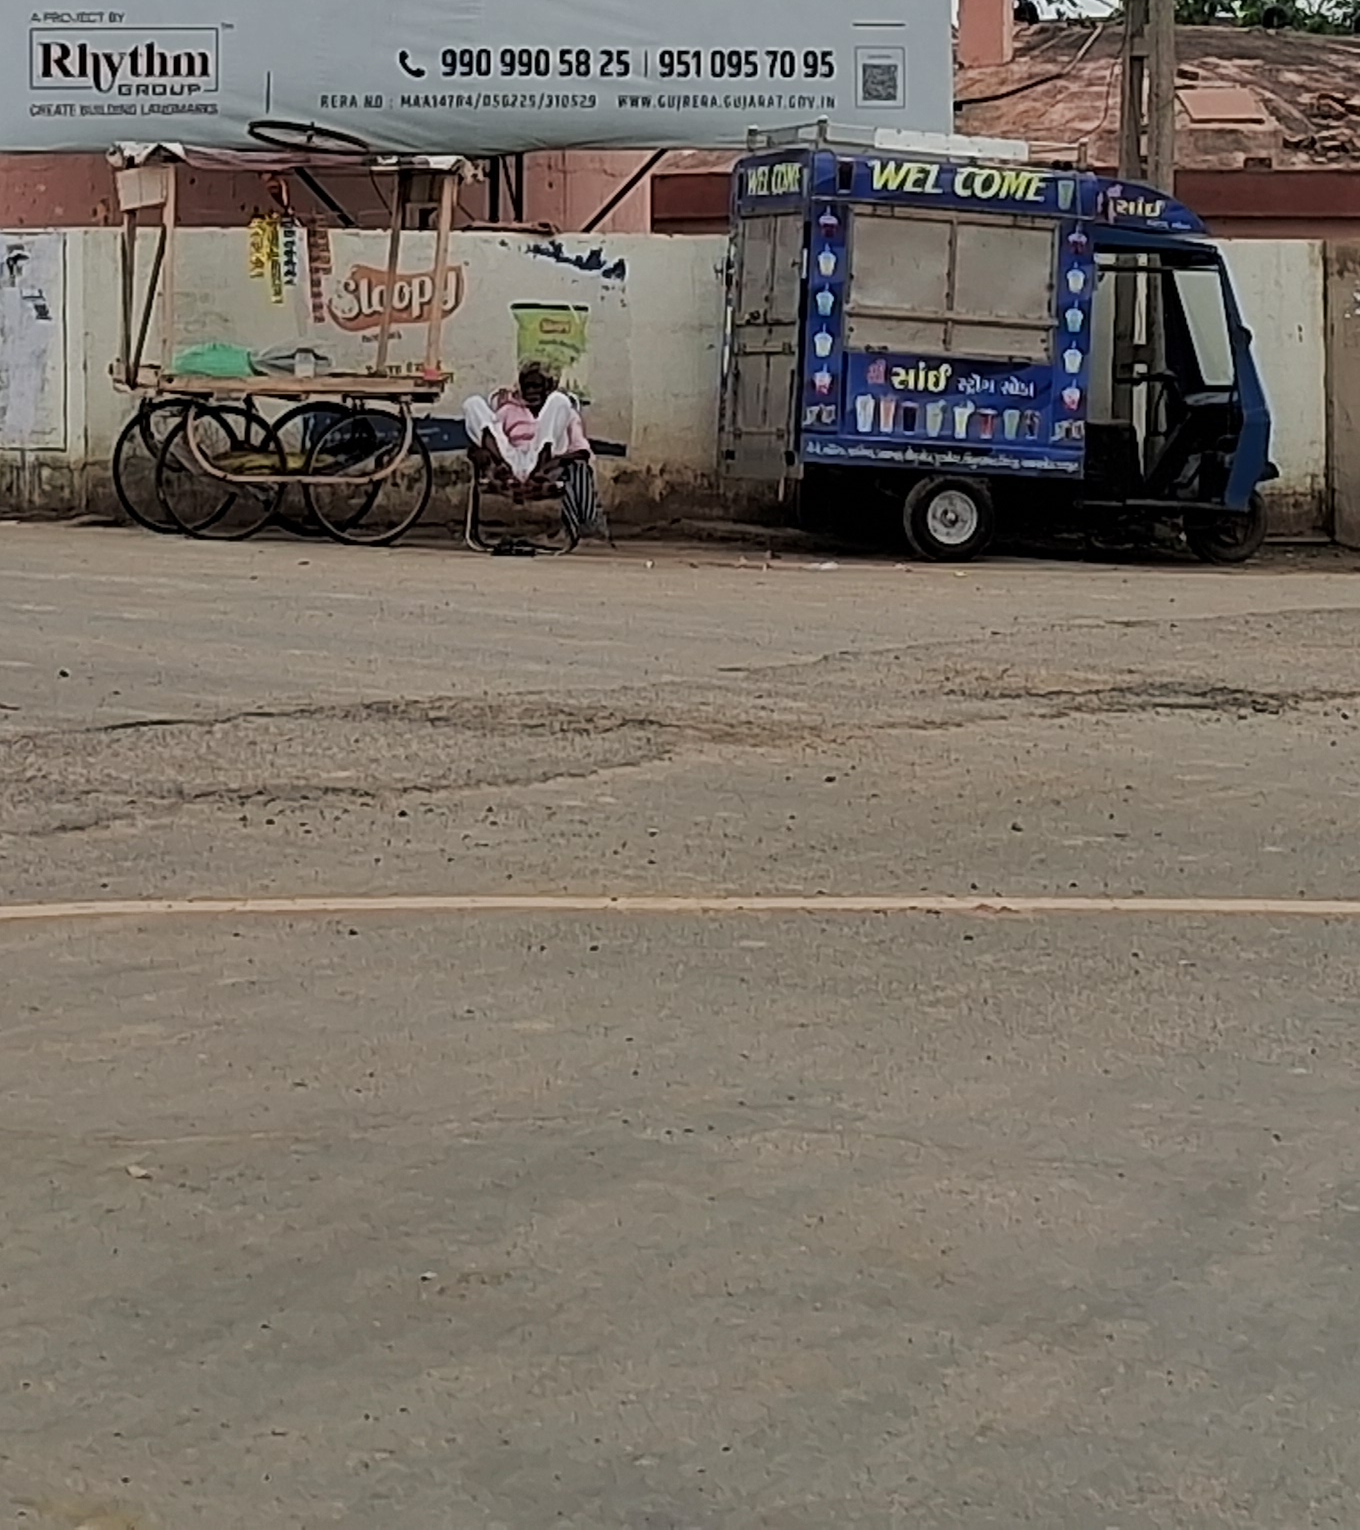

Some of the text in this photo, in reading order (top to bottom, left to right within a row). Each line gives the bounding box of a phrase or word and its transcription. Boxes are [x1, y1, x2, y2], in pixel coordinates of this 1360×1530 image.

[43, 12, 104, 23] PROJECT
[109, 12, 125, 23] BY
[37, 41, 210, 93] Rhythm
[441, 48, 835, 78] 990 990 58 25 951 095 70 95
[118, 83, 202, 96] GROUP
[320, 94, 357, 109] RERA
[867, 159, 1054, 202] WEL COME
